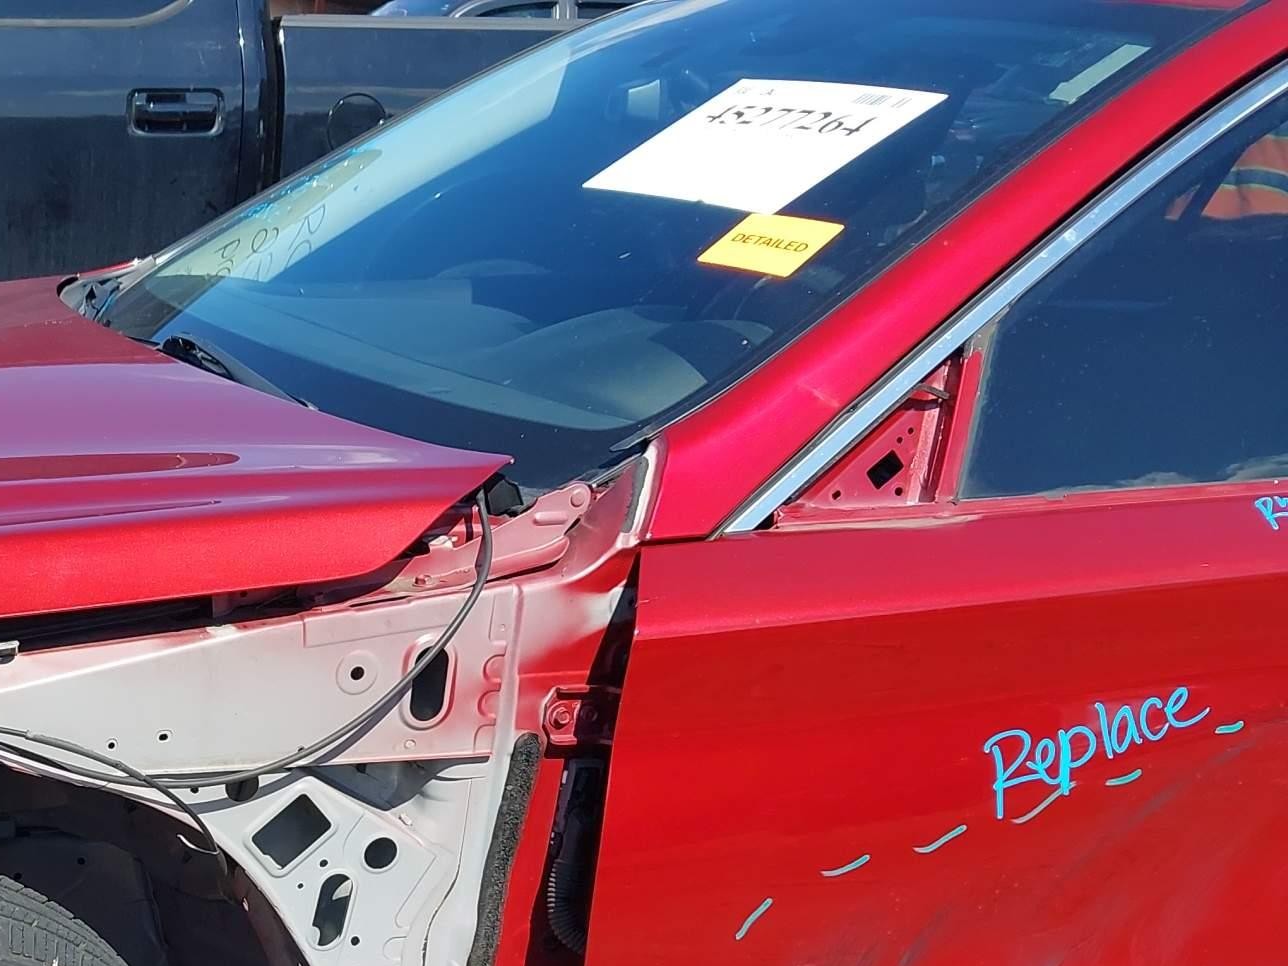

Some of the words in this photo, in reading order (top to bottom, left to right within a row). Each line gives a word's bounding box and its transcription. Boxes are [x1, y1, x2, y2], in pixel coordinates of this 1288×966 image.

[706, 105, 878, 136] 45277264
[731, 233, 809, 252] DETAILED
[984, 687, 1210, 820] Replace
